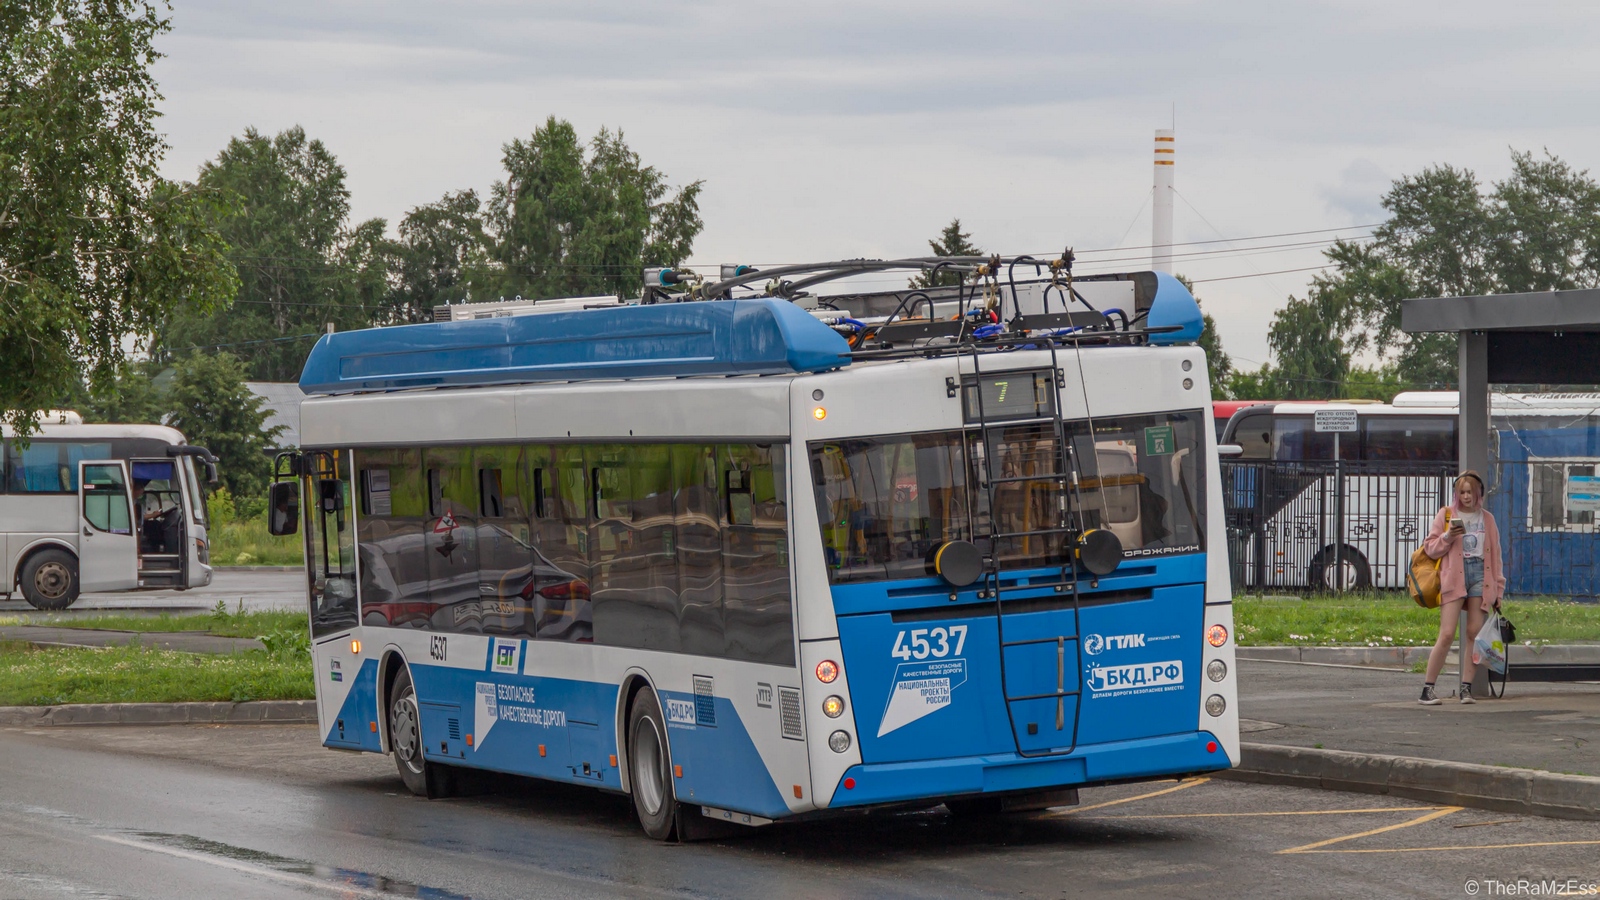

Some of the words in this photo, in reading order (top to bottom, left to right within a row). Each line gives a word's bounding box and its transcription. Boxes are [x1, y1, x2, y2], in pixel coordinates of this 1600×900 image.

[994, 381, 1008, 402] 7
[1122, 544, 1199, 557] ОРОЖАНИН
[430, 635, 447, 661] 4537
[891, 625, 968, 661] 4537
[1105, 633, 1146, 650] ГТЛК
[903, 669, 942, 677] КАЧЕСТВЕННЫЕ
[1106, 664, 1179, 685] БКД.РФ
[899, 679, 948, 690] НАЦИОНАЛЬНЫЕ
[921, 687, 949, 696] ПРОЕКТЫ
[1113, 689, 1132, 697] ДОРОГИ
[497, 684, 535, 704] БЕЗОПАСНЫЕ
[926, 696, 949, 704] РОССИИ
[500, 705, 543, 726] КАЧЕСТВЕННЫЕ
[543, 708, 566, 729] ДОРОГИ
[671, 703, 695, 720] БКД.РФ
